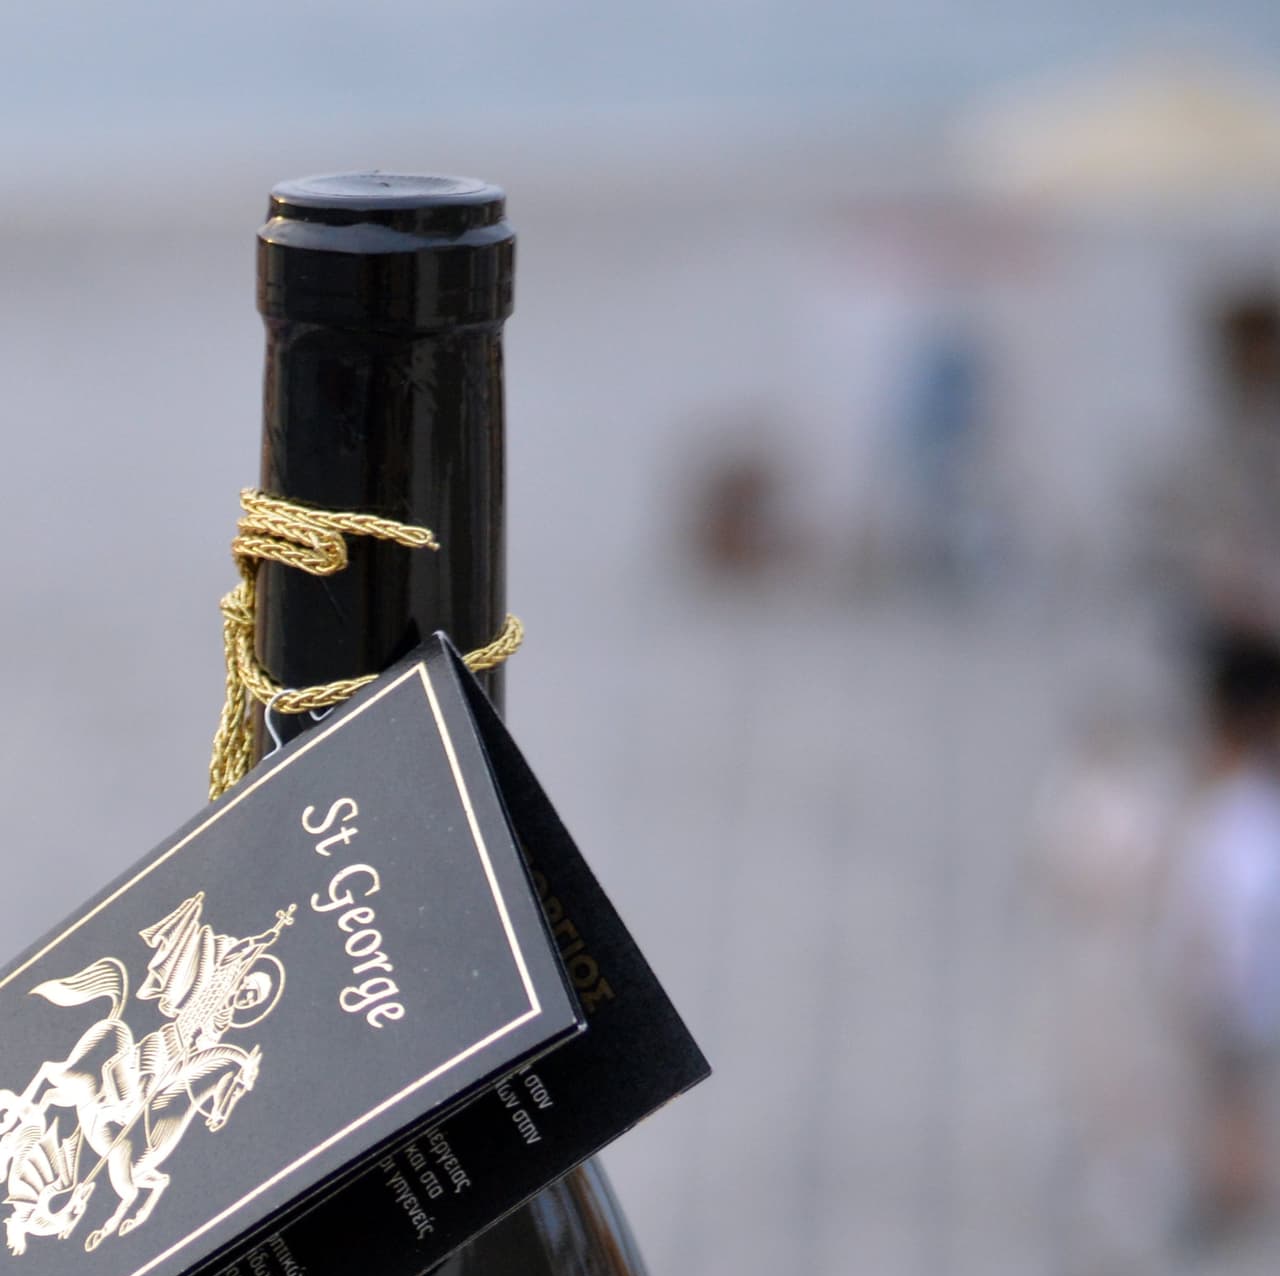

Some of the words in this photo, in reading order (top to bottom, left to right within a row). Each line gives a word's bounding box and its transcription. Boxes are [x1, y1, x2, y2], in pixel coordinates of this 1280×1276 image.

[302, 798, 358, 856] St
[310, 864, 405, 1028] George
[512, 1110, 542, 1144] στην
[420, 1171, 443, 1199] στα
